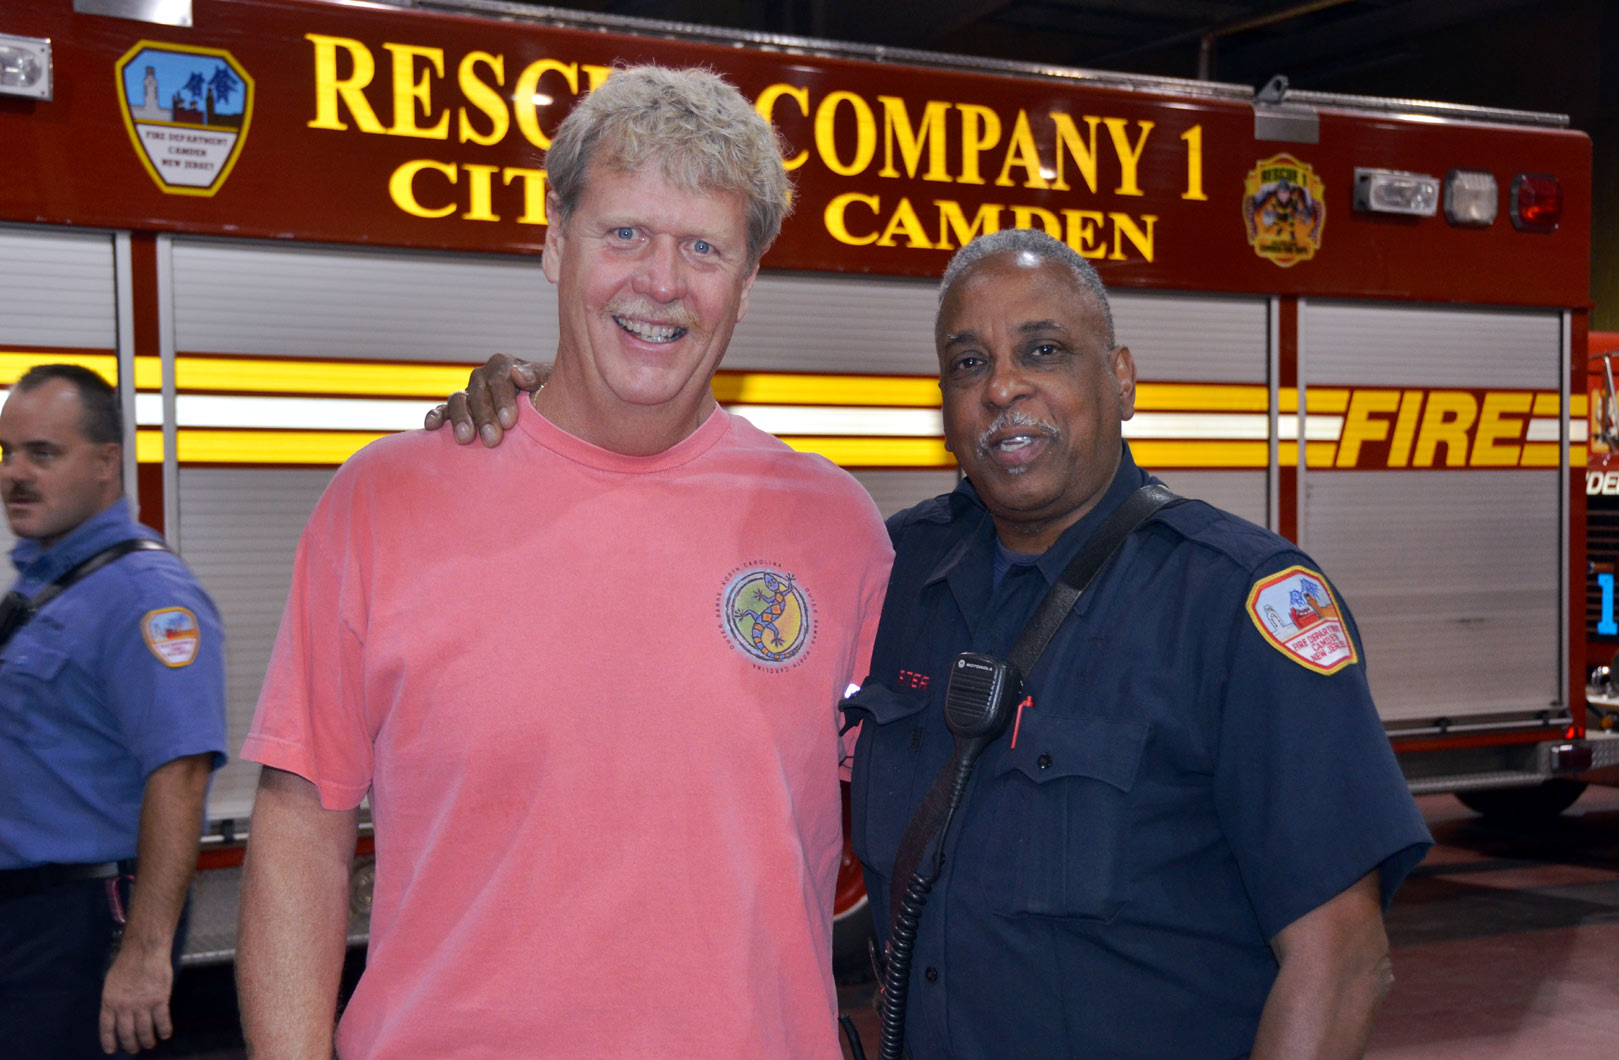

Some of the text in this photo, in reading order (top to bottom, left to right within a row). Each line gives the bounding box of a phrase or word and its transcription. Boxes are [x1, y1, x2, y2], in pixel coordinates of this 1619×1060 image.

[305, 33, 1208, 200] RESC COMPANY 1
[146, 131, 228, 145] FIRE DEPARTMENT
[168, 146, 207, 156] CAMDEN
[162, 159, 214, 170] NEW JERSEY
[389, 158, 1159, 263] CIT CAMDEN
[1335, 389, 1534, 468] FIRE
[1292, 638, 1309, 652] FIRE
[1310, 650, 1327, 661] NEW
[966, 662, 993, 672] MOTOROLA
